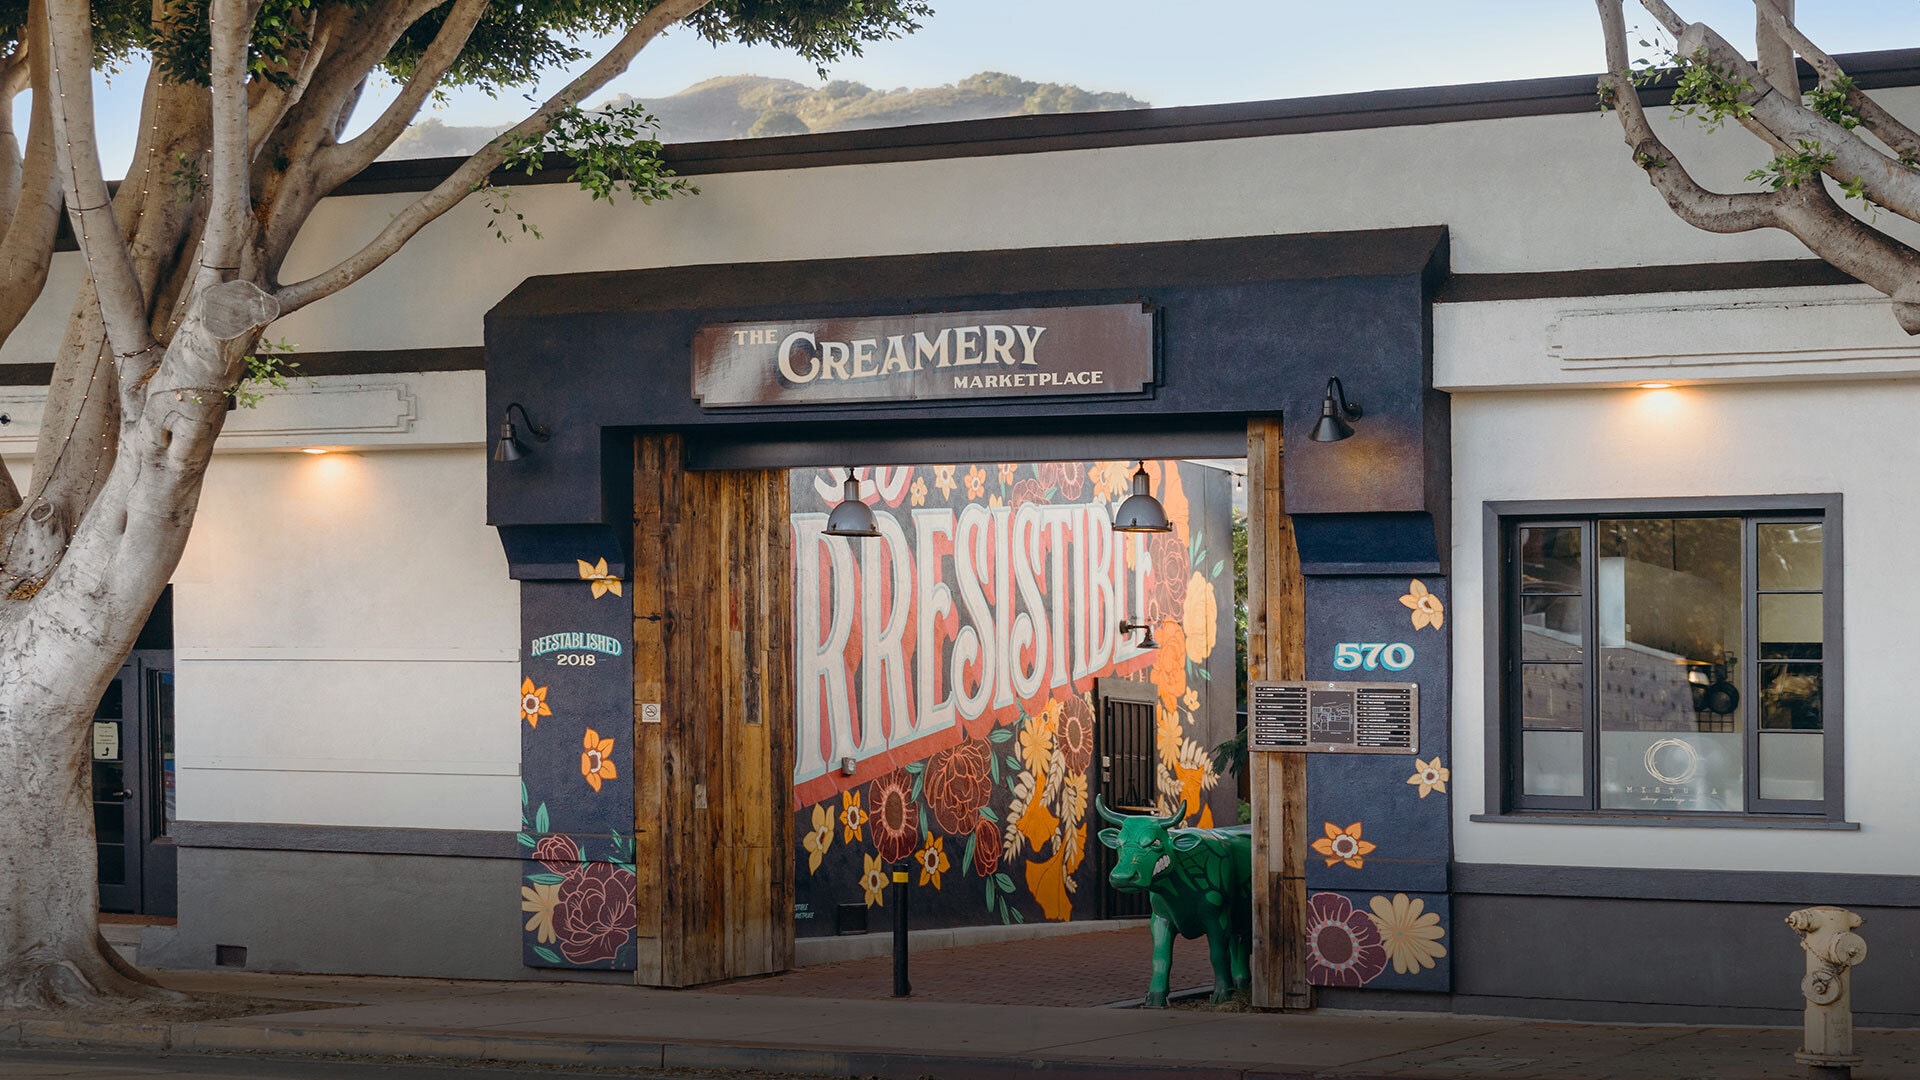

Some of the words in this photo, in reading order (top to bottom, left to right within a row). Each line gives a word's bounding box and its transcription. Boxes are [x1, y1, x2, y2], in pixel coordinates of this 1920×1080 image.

[734, 329, 778, 345] THE
[777, 325, 1047, 384] CREAMERY
[953, 370, 1103, 389] MARKETPLACE
[531, 632, 622, 657] REESTABLISHED
[793, 501, 1154, 785] RRESISTIBLE
[1333, 642, 1415, 671] 570
[556, 654, 596, 666] 2018
